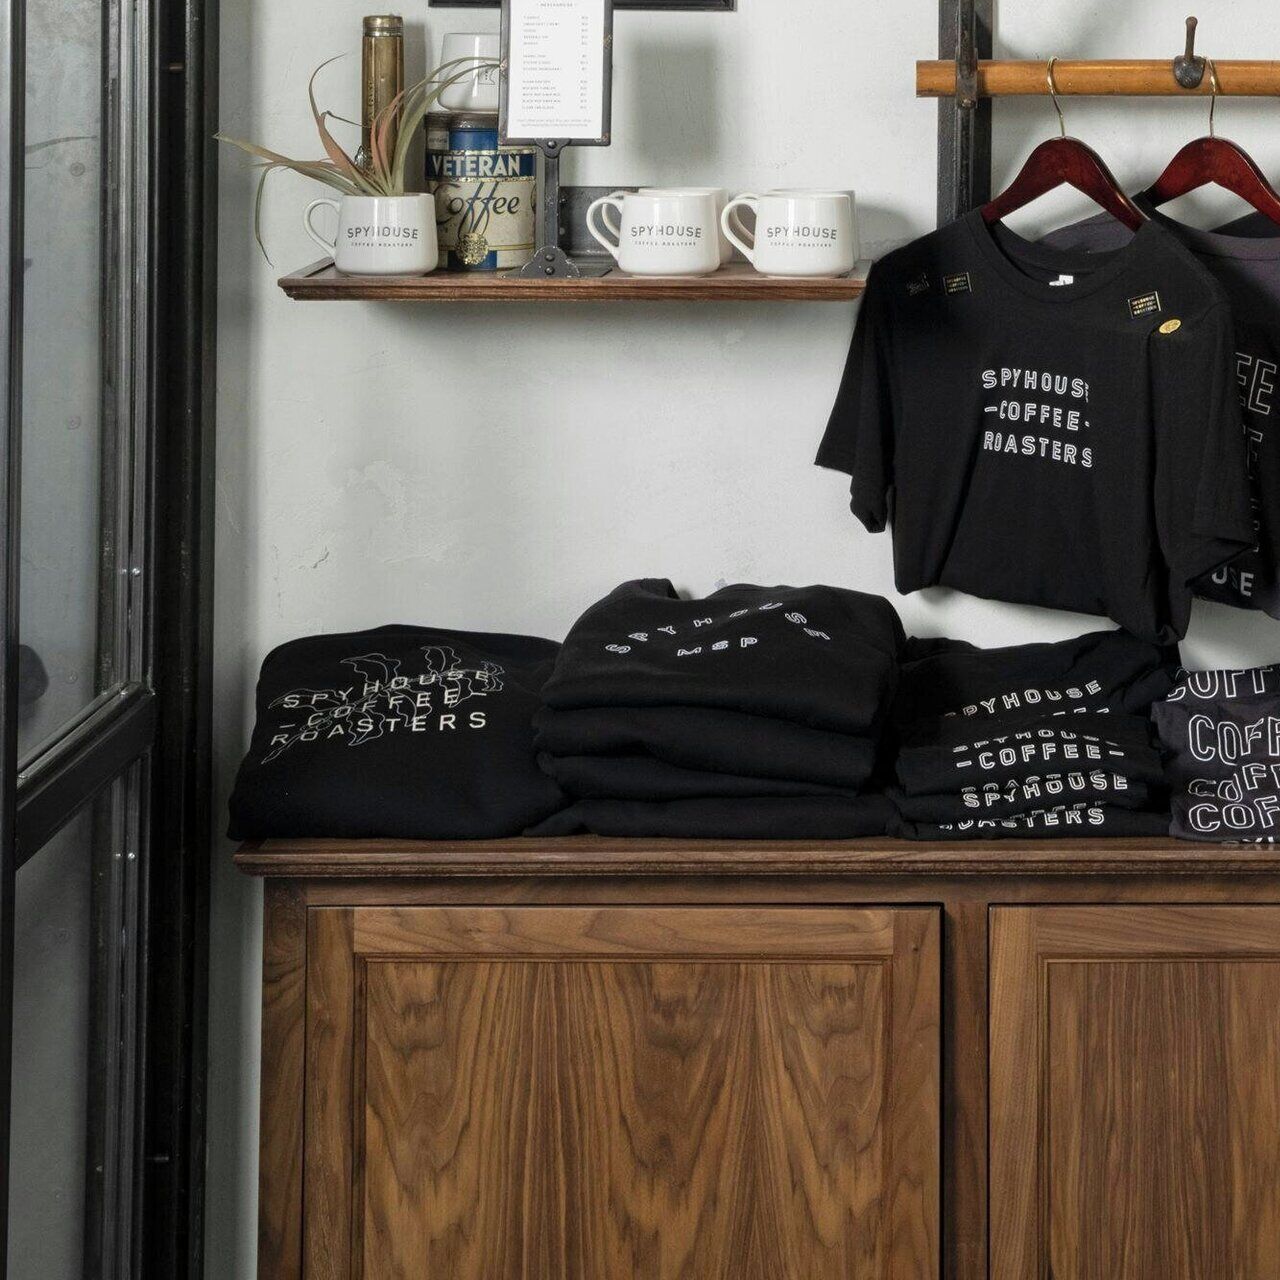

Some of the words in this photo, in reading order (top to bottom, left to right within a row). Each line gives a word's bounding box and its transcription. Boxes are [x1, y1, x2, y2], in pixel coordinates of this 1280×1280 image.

[432, 155, 521, 177] VETERAN
[433, 182, 520, 237] Coffee
[347, 226, 419, 239] SPYHOUSE
[631, 225, 702, 238] SPYHOUSE
[767, 226, 838, 239] SPYHOUSE
[983, 431, 1093, 468] ROASTERS
[677, 637, 758, 657] MSP
[283, 669, 489, 708] SPYHOUSE
[944, 679, 1102, 717] PYHOUSE
[270, 711, 487, 746] ROASTERS
[963, 773, 1128, 808] SPYHOUSE
